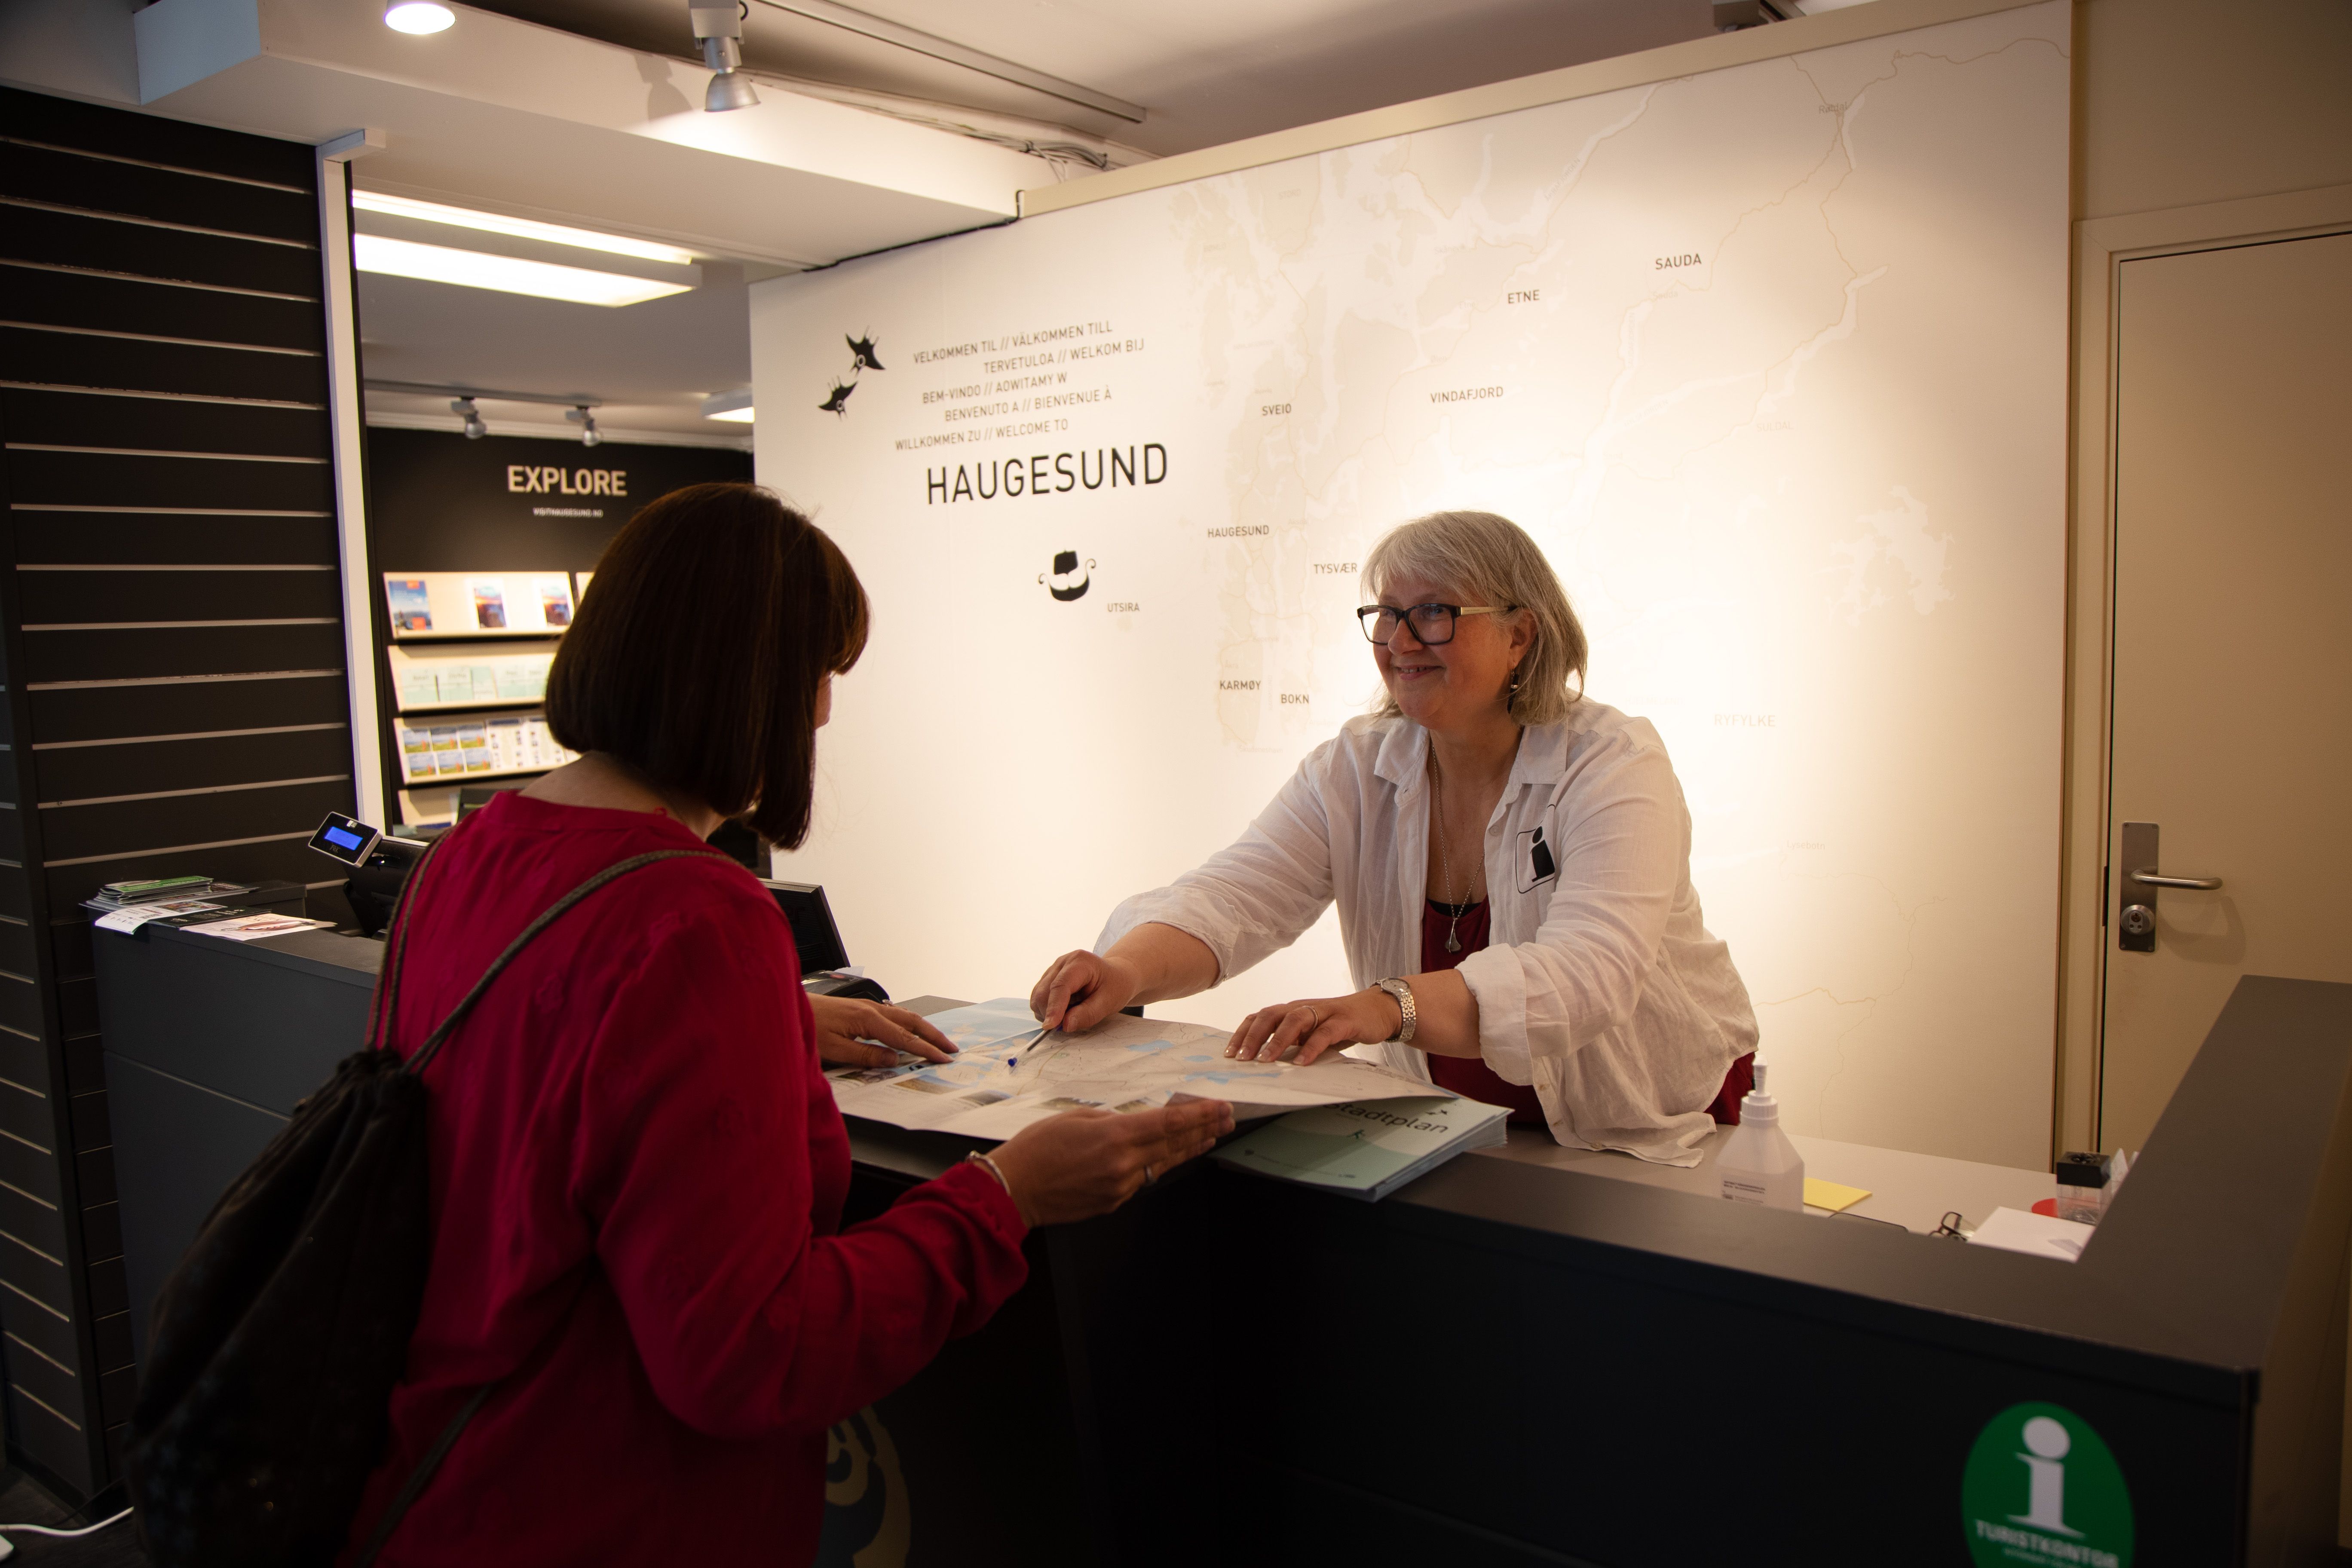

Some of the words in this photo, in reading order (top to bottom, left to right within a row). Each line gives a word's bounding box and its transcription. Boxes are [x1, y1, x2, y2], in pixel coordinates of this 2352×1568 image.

[1655, 253, 1702, 270] SAUDA
[1507, 289, 1539, 304] ETNE
[913, 343, 977, 364] VELKOMMEN
[980, 340, 997, 352] TIL
[1012, 325, 1084, 347] VÄLKOMMEN
[1087, 321, 1112, 334] TILL
[984, 352, 1054, 374] TERVETULOA
[1070, 342, 1121, 360] WELKOM
[1126, 339, 1144, 352] BIJ
[922, 385, 980, 404] BEM-VINDO
[1057, 373, 1066, 383] W
[1430, 386, 1504, 404] VINDAFJORD
[944, 402, 1008, 422] BENVENUTO
[1012, 401, 1019, 412] A
[1034, 389, 1100, 410] BIENVENUE
[1103, 384, 1113, 400] À
[1262, 403, 1292, 416] SVEIO
[894, 432, 964, 451] WILLKOMMEN
[968, 430, 981, 443] ZU
[995, 420, 1050, 438] WELCOME
[1054, 418, 1068, 431] TO
[507, 464, 627, 496] EXPLORE
[927, 443, 1167, 505] HAUGESUND
[1207, 524, 1269, 538] HAUGESUND
[1313, 563, 1357, 574] TYSVÆR
[1107, 602, 1140, 612] UTSIRA
[1219, 680, 1261, 690] KARMØY
[1280, 694, 1309, 704] BOKN
[1714, 713, 1776, 727] RYFYLKE
[1787, 839, 1825, 850] Lysebotn
